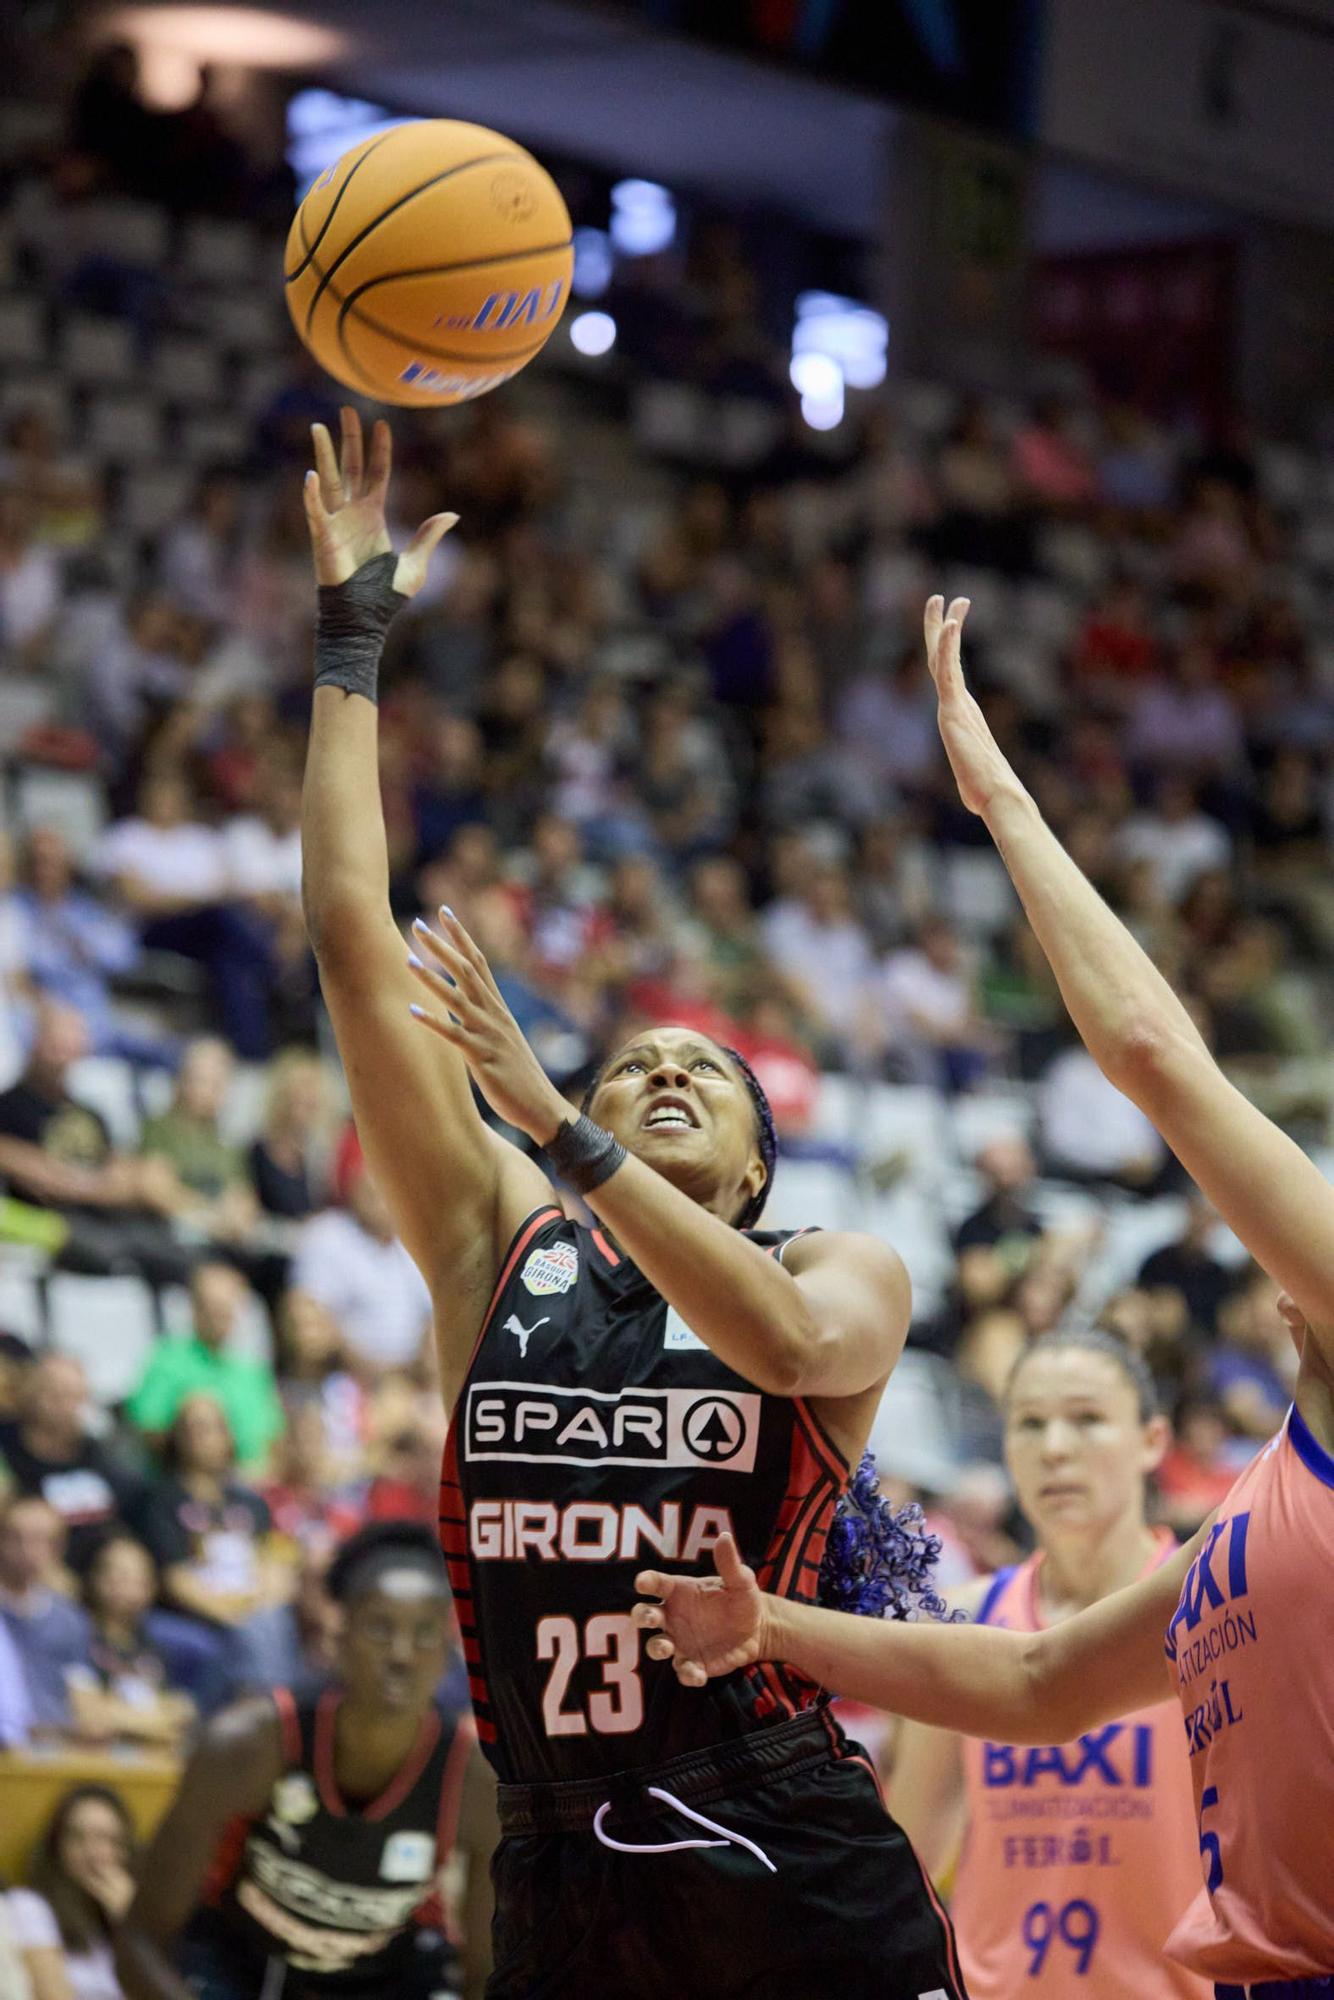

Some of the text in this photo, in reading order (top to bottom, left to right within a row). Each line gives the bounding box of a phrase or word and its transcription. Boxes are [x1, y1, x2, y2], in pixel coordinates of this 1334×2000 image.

[524, 1266, 570, 1291] GIRONA
[474, 1399, 664, 1449] SPAR
[469, 1501, 743, 1563] GIRONA
[536, 1613, 645, 1738] 23
[1178, 1610, 1258, 1687] ATIZACIÓN
[983, 1724, 1153, 1788] BAXI
[1022, 1897, 1100, 1977] 99
